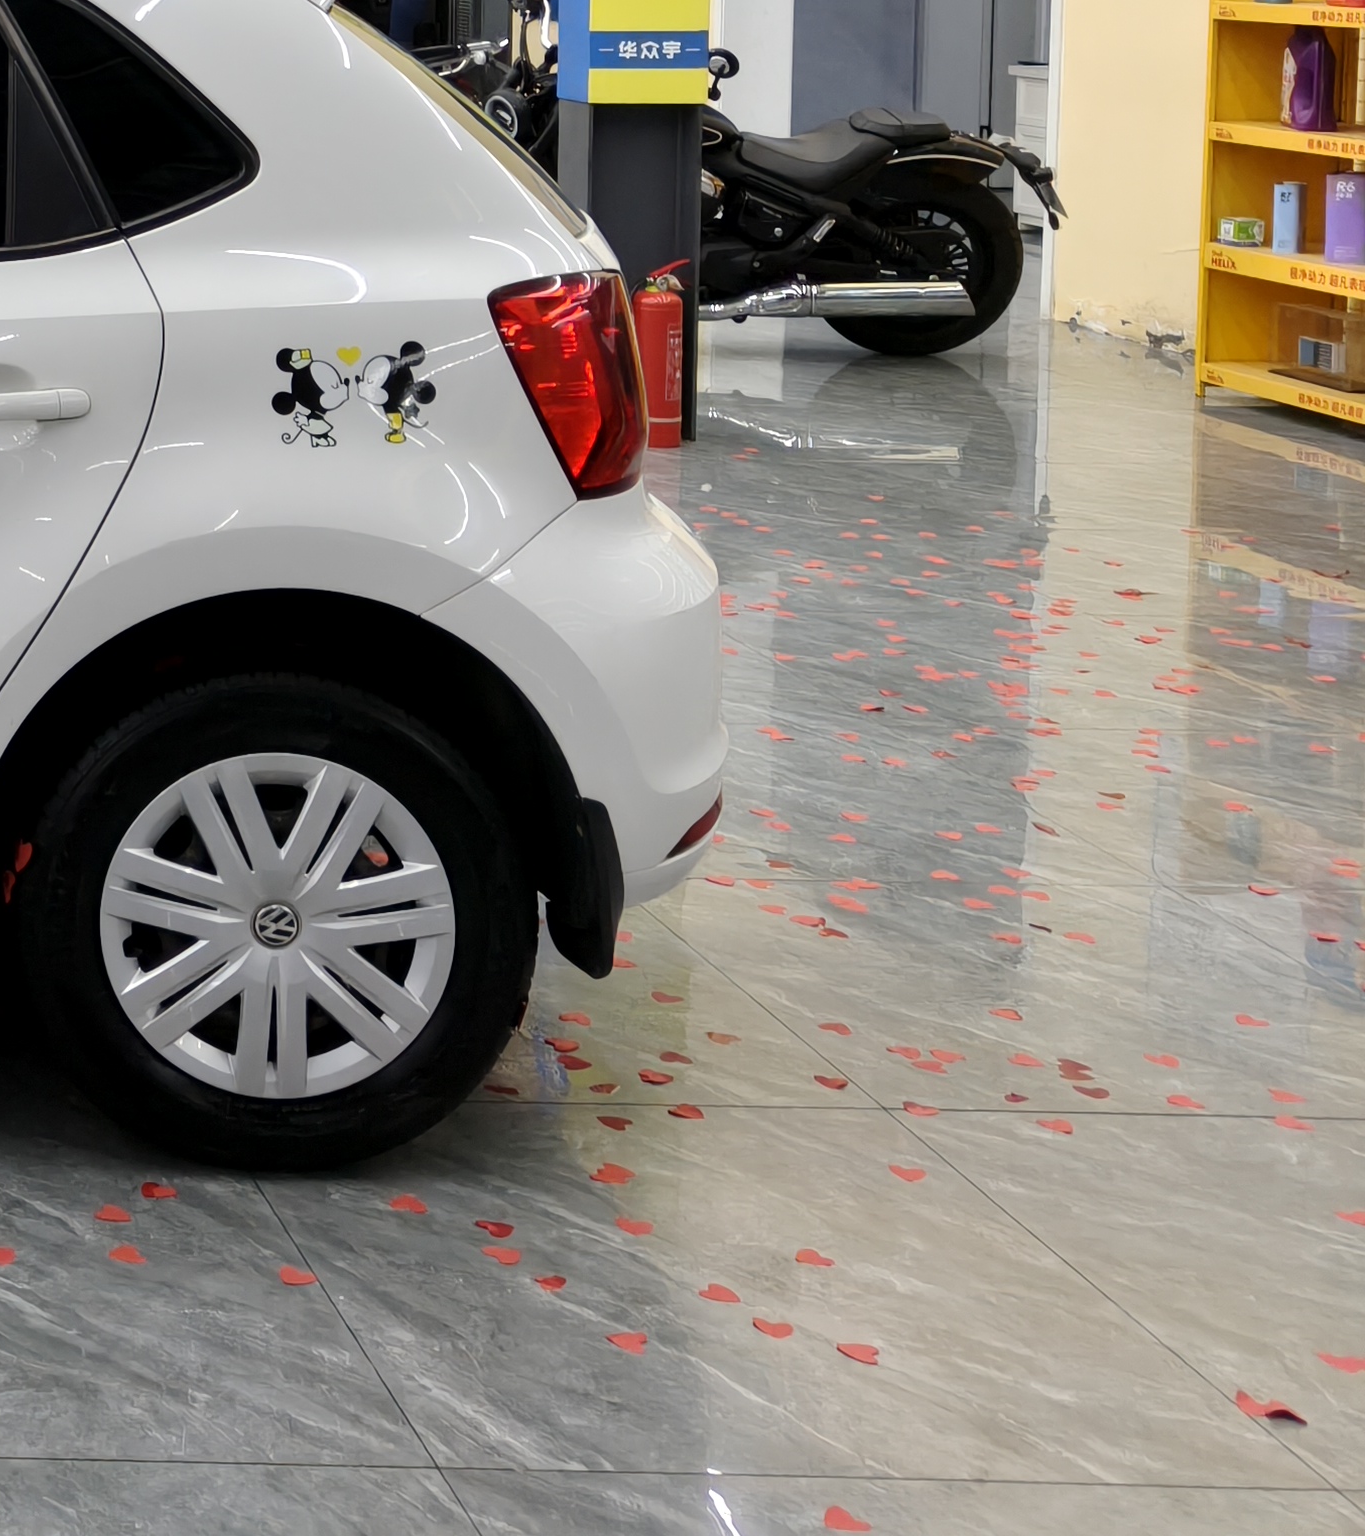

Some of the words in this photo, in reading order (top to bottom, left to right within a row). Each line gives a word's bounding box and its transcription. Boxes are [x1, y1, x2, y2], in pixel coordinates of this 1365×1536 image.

[618, 40, 682, 60] 华众宇
[1211, 258, 1237, 270] HELIX
